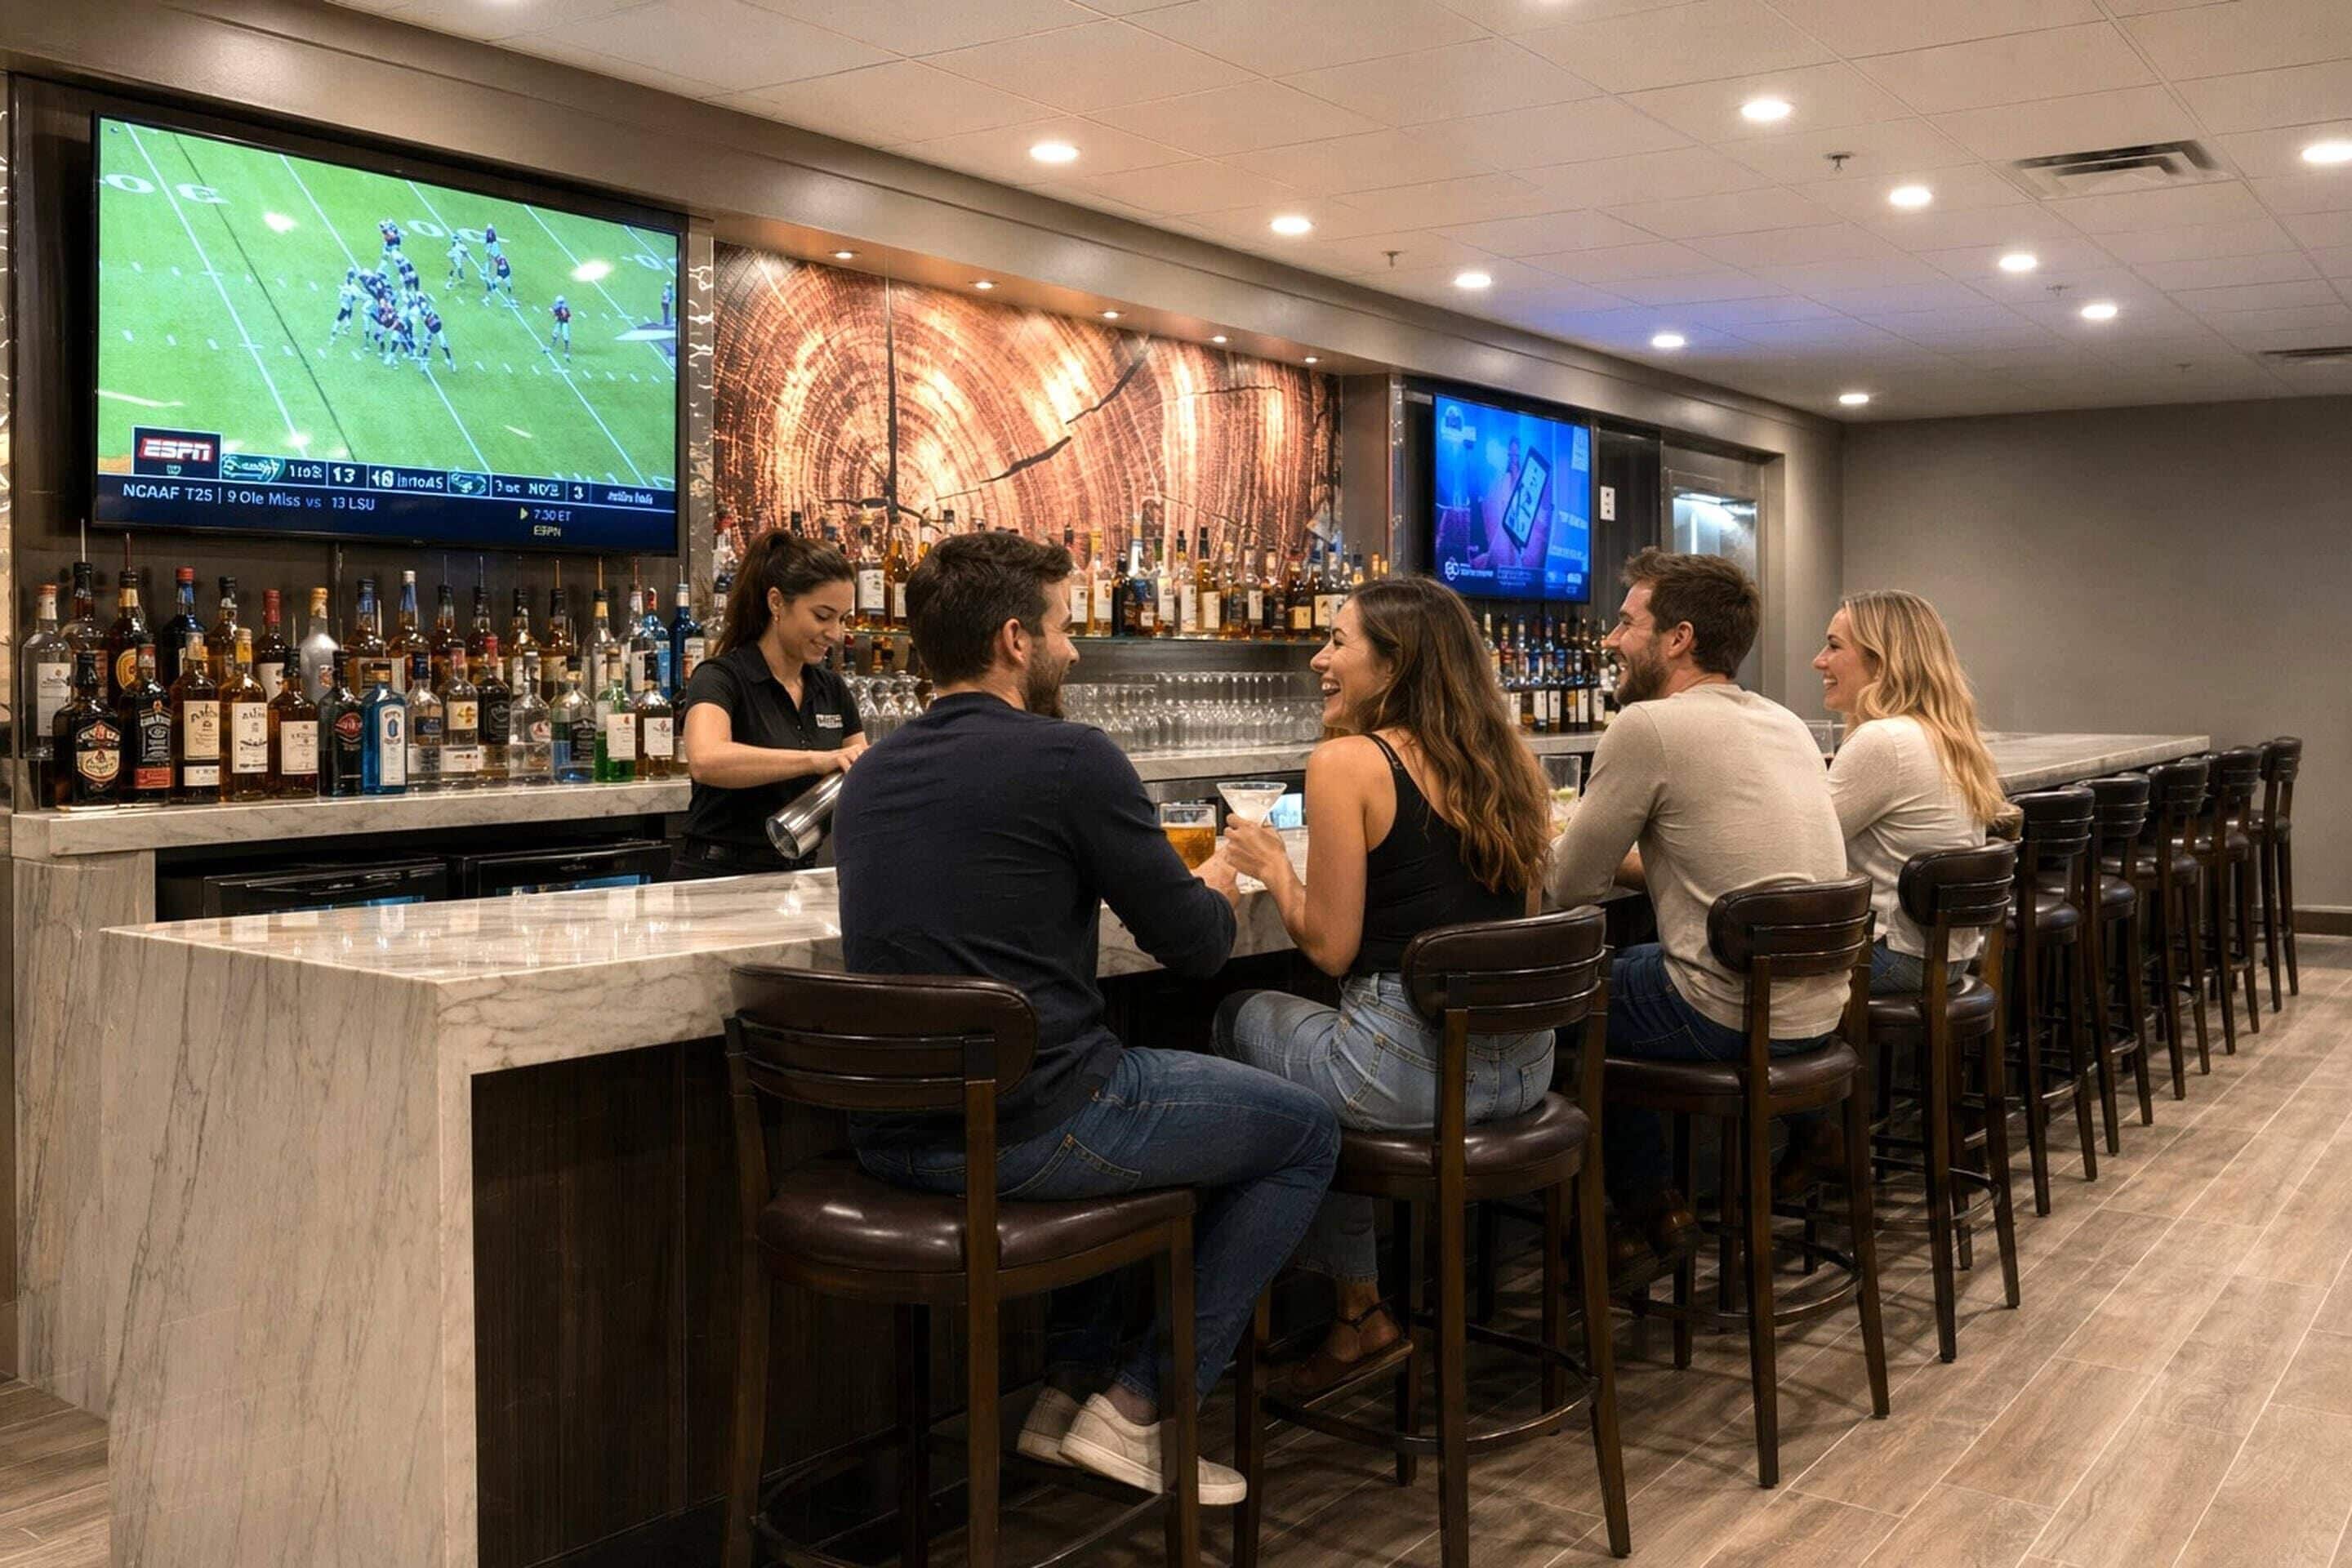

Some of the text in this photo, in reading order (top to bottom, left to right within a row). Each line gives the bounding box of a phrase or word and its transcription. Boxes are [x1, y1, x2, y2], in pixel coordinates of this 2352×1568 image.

[143, 438, 212, 461] ESPN
[332, 466, 356, 483] 13
[122, 483, 180, 500] NCAAF
[185, 487, 213, 501] T25
[227, 490, 237, 503] 9
[239, 491, 264, 505] Ole
[305, 497, 321, 508] vs
[332, 497, 345, 509] 13
[349, 497, 375, 510] LSU
[558, 510, 572, 522] ET
